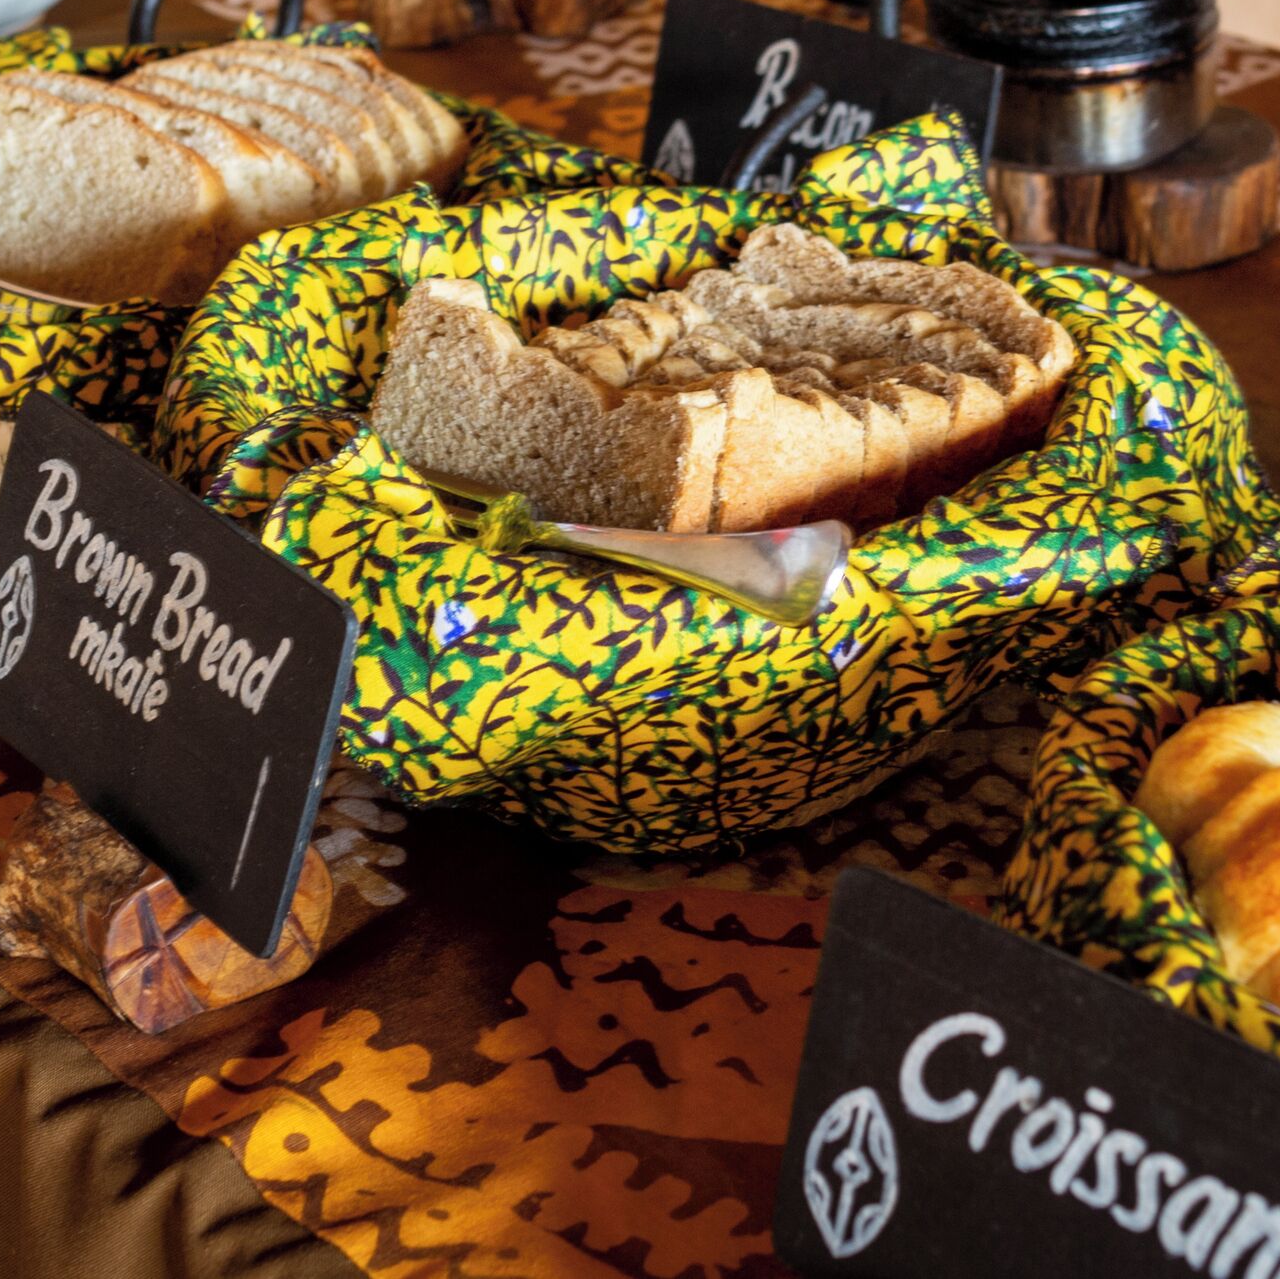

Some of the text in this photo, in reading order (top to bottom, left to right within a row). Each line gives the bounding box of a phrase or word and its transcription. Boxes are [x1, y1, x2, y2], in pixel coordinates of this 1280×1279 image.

[738, 37, 875, 150] Bcon
[24, 458, 293, 715] Brown Bread
